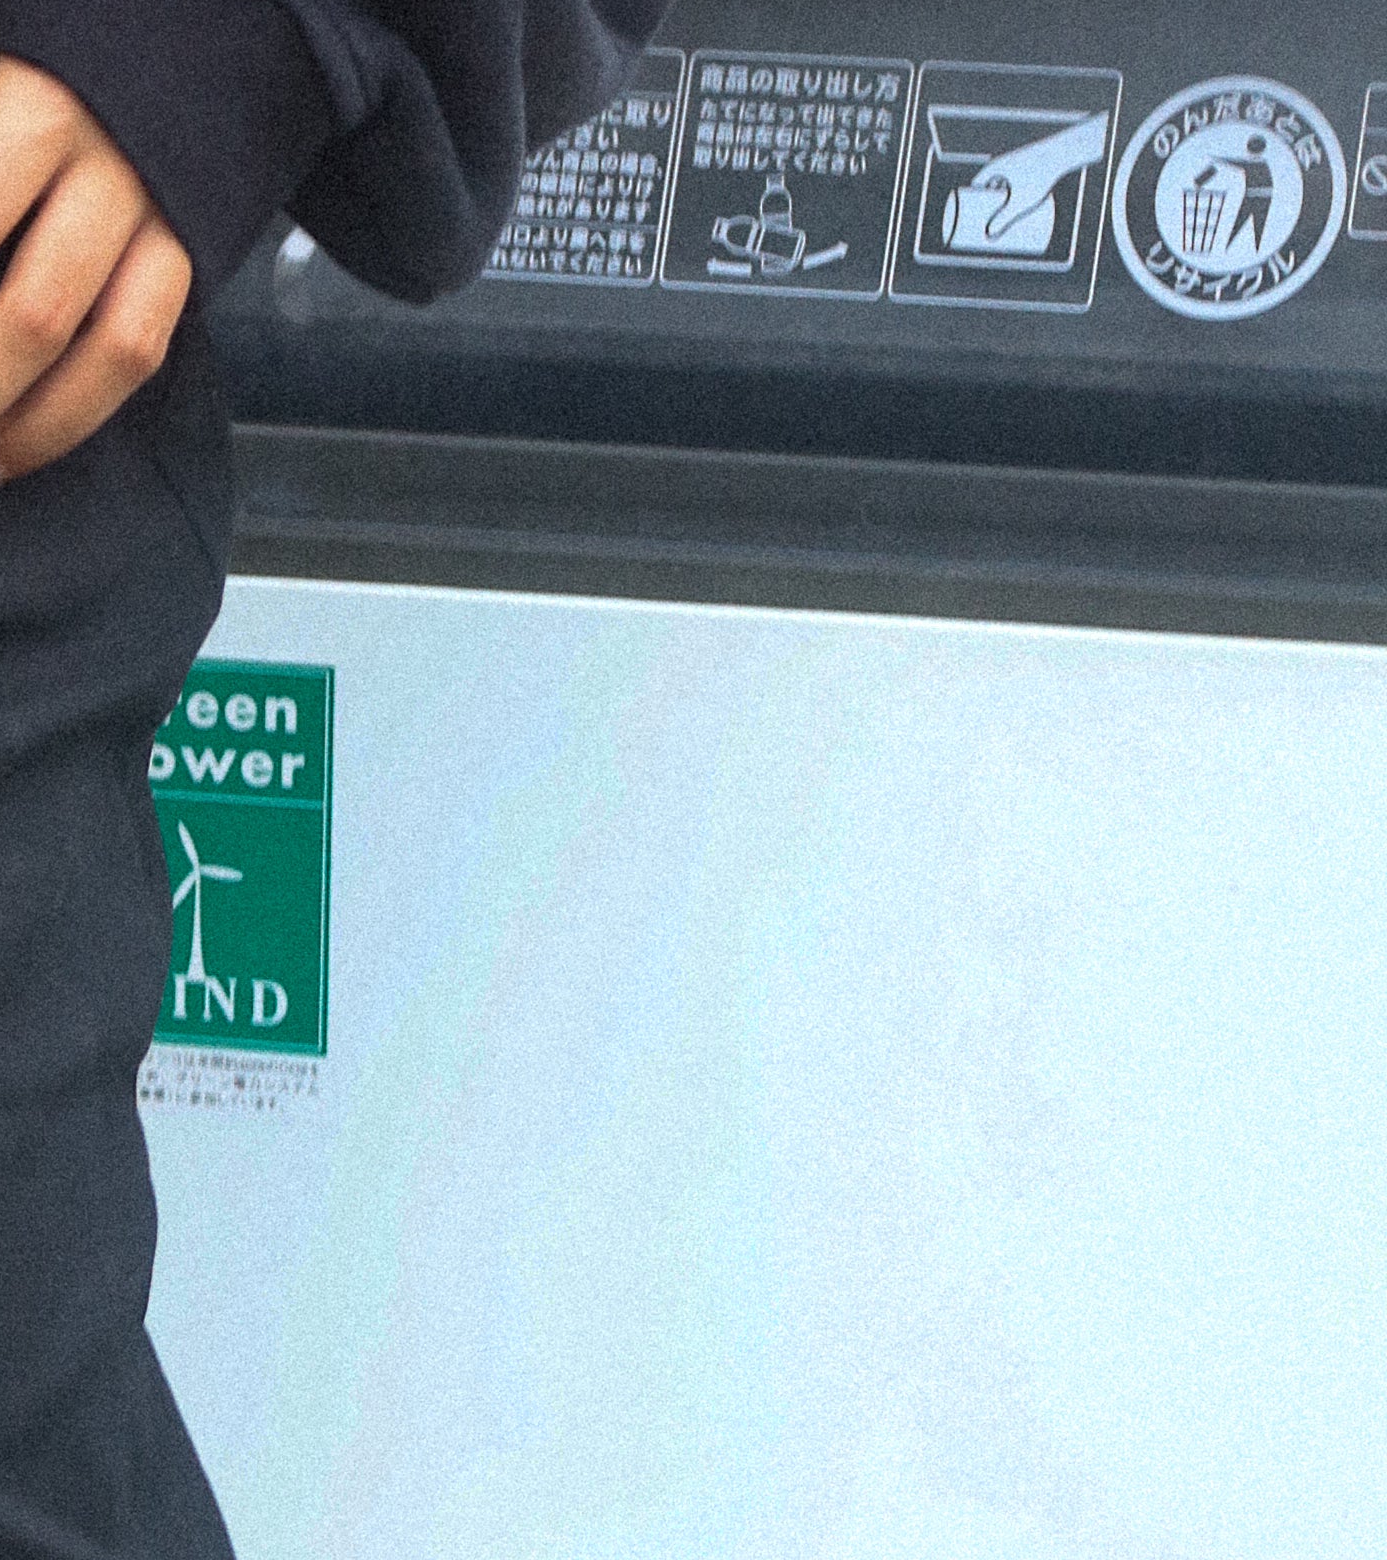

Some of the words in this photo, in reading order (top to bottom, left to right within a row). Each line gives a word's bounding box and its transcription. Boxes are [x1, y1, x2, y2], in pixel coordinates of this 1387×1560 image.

[699, 62, 901, 102] 商品の取り出し方
[700, 97, 893, 132] たてになって出てきた
[692, 142, 867, 176] 取り出してください
[1145, 240, 1296, 301] リサイクル
[165, 690, 299, 734] een
[148, 743, 305, 789] ower
[172, 973, 289, 1028] IND
